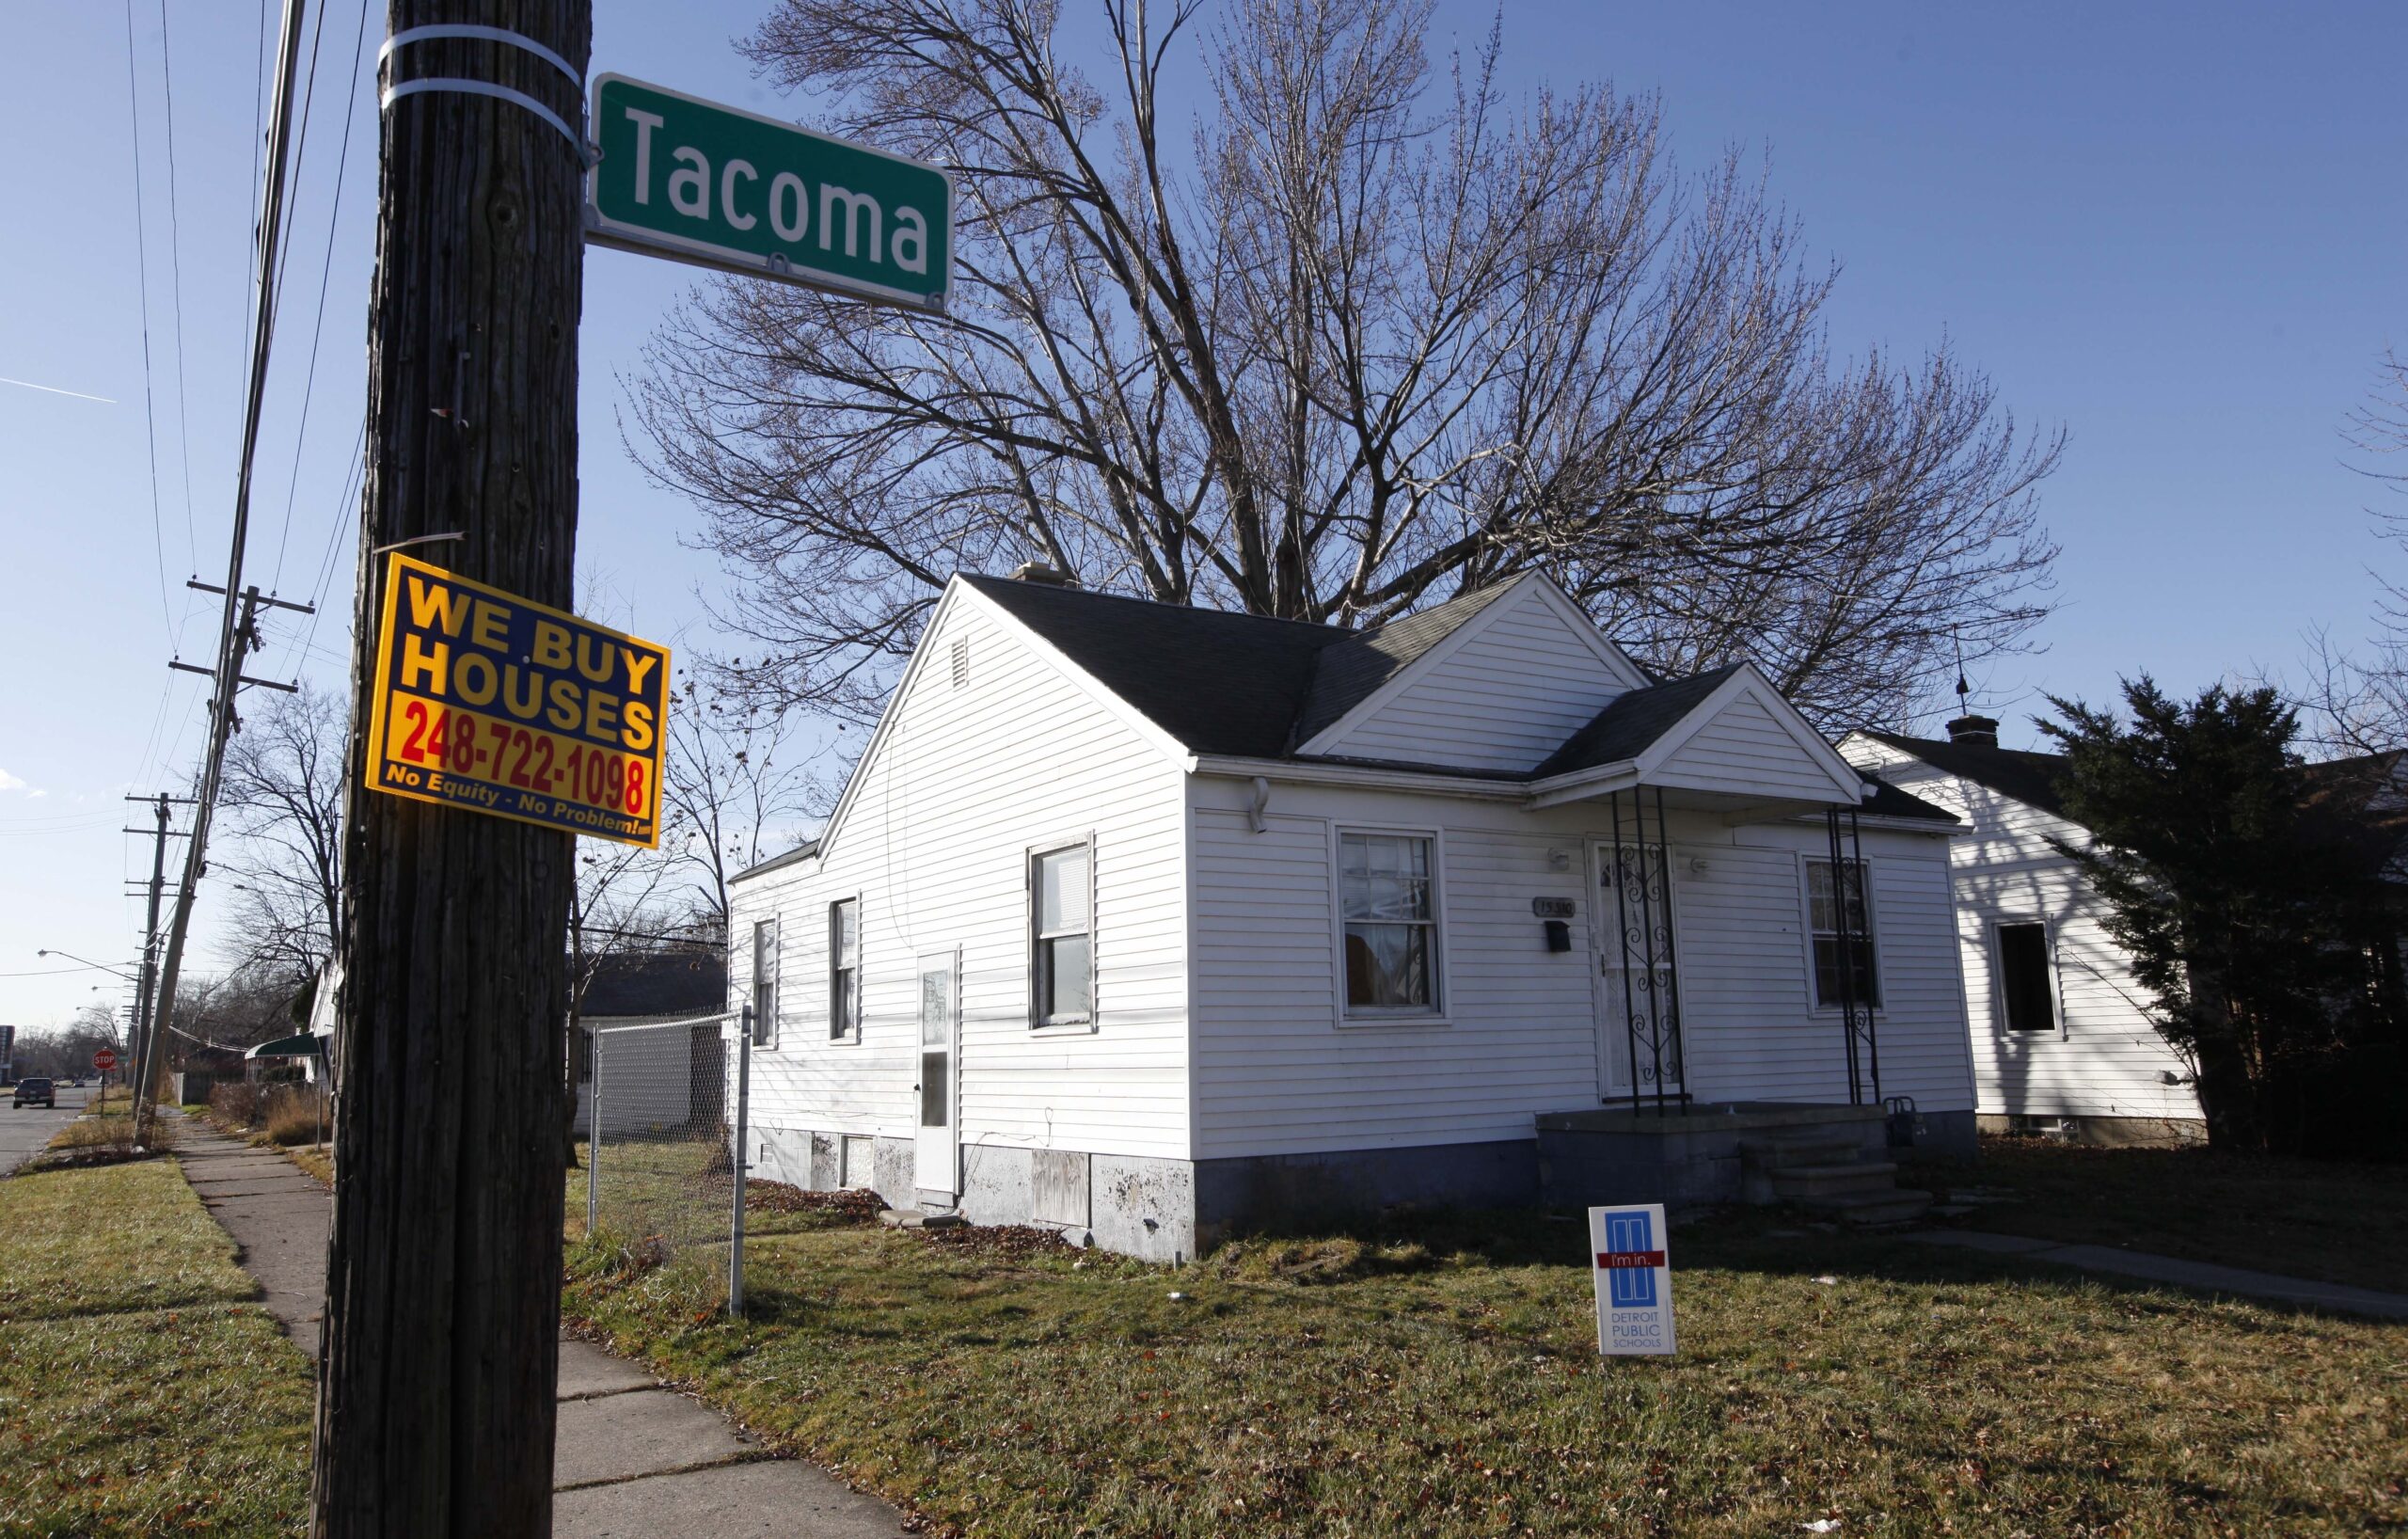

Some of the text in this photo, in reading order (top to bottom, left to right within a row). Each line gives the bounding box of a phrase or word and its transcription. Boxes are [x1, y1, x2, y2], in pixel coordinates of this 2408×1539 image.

[625, 106, 927, 276] Tacoma
[408, 576, 657, 695] WE BUY
[401, 632, 654, 751] HOUSES
[400, 701, 644, 815] 248-722-1098
[386, 764, 420, 786] No
[427, 773, 499, 807] Equity
[518, 794, 547, 814] No
[553, 802, 639, 834] Problem!
[95, 1055, 115, 1064] STOP
[1611, 1253, 1651, 1266] I'm in.
[1611, 1311, 1658, 1324] DETROIT
[1612, 1325, 1660, 1337] PUBLIC
[1613, 1339, 1661, 1348] SCHOOLS
